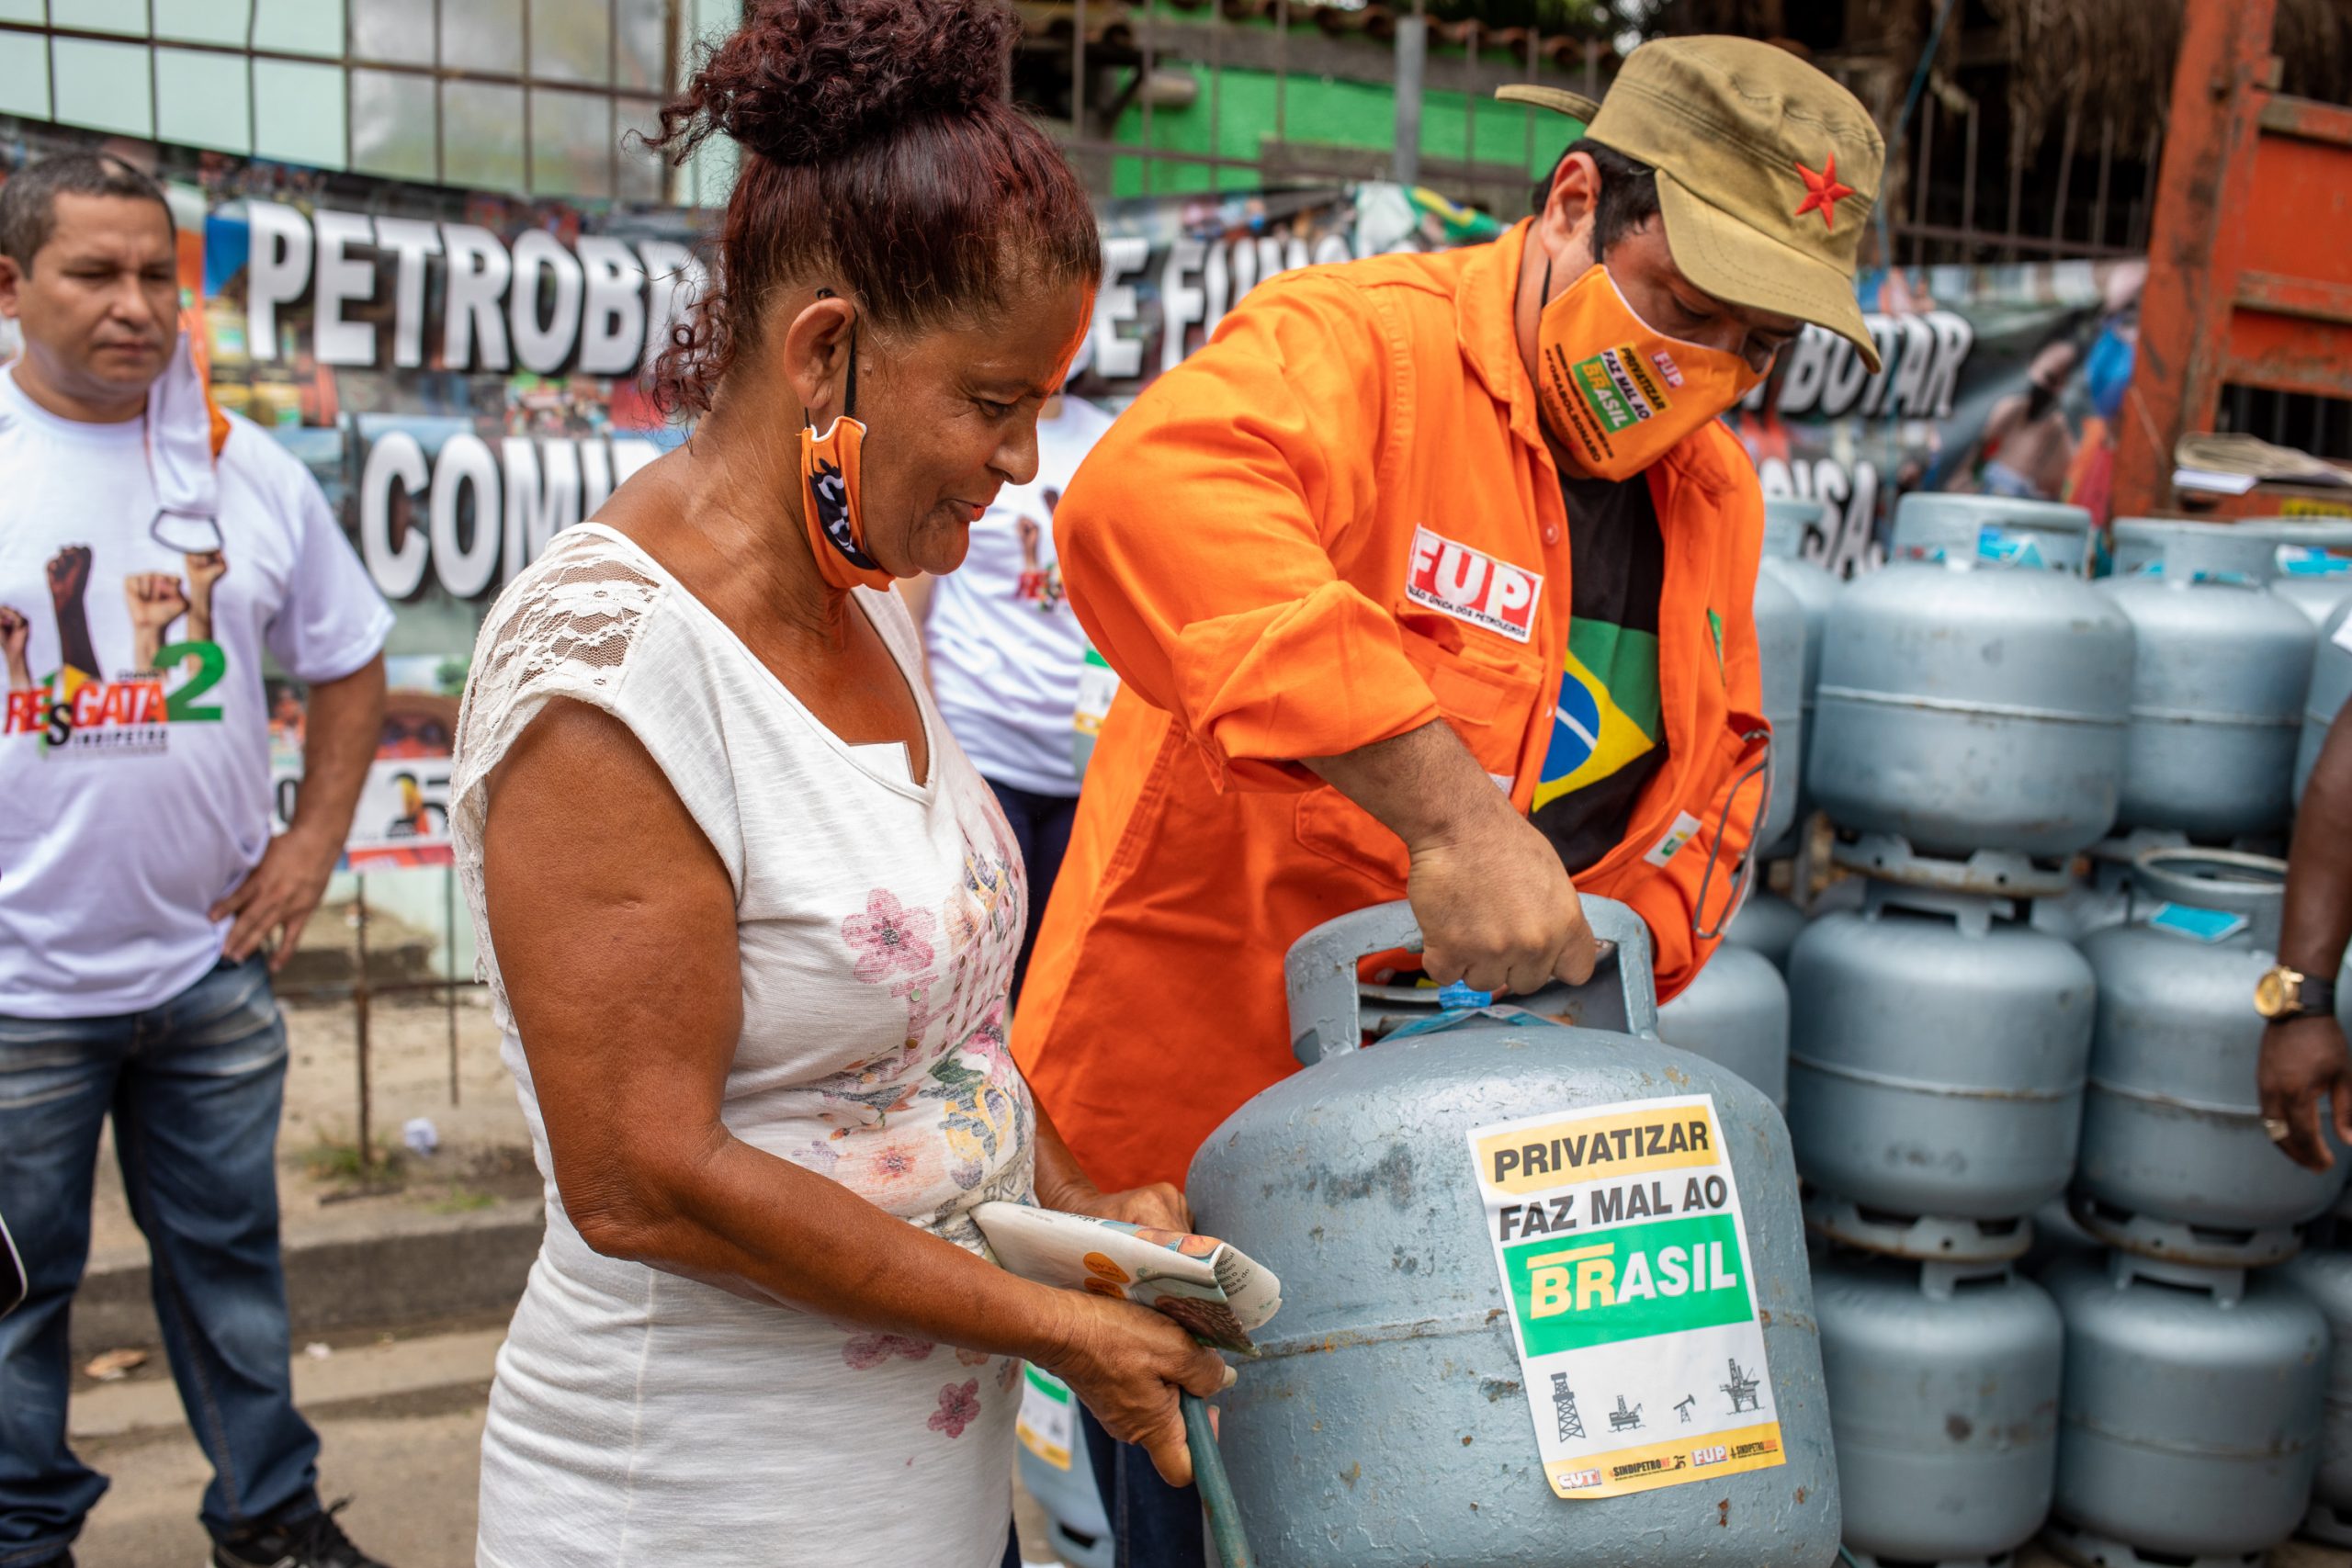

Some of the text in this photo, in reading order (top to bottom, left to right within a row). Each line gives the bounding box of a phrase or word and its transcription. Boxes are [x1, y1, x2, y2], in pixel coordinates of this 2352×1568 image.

[248, 201, 712, 375] PETROBR
[1777, 310, 1973, 419] BOTAR
[1580, 358, 1631, 428] BRASIL
[1602, 349, 1650, 421] FAZ MAL AO
[1620, 345, 1665, 411] PRIVATIZAR
[1411, 532, 1531, 619] FUP
[1456, 605, 1473, 617] DOS
[1476, 612, 1526, 637] PETROLEIROS
[153, 639, 225, 721] 2
[1494, 1121, 1709, 1183] PRIVATIZAR
[1499, 1175, 1727, 1242] FAZ MAL AO
[1526, 1241, 1737, 1319] BRASIL
[1557, 1469, 1599, 1488] CUT
[1692, 1446, 1726, 1466] FUP
